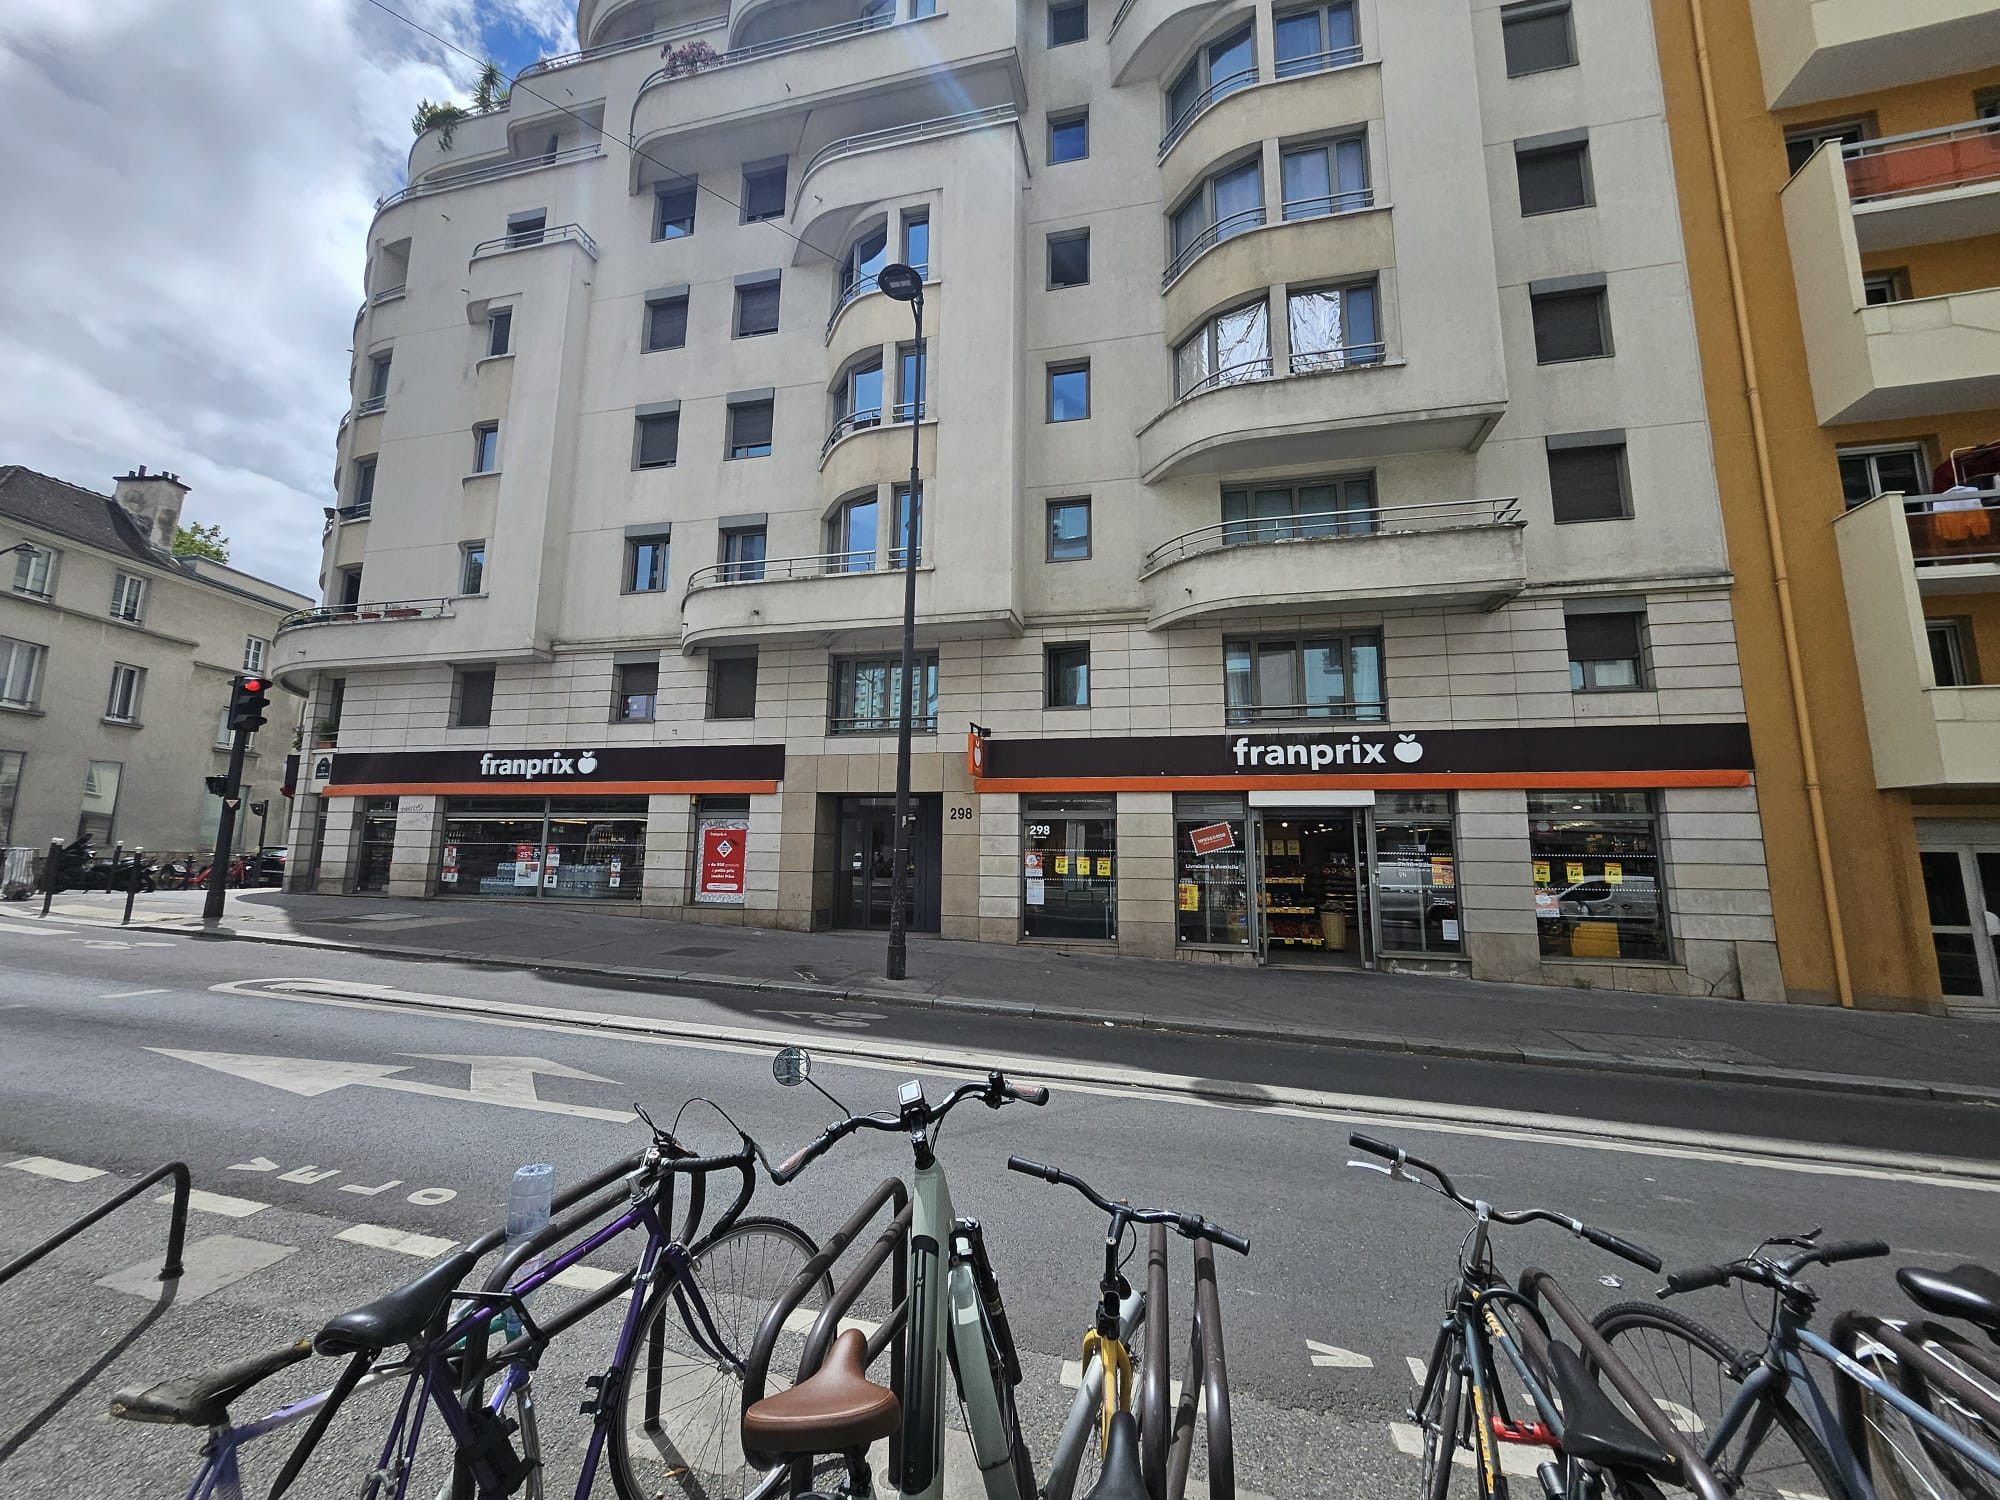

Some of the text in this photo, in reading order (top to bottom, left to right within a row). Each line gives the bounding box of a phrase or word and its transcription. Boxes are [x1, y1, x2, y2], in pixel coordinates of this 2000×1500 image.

[480, 752, 574, 780] franprix
[1233, 735, 1386, 771] franprix
[950, 807, 973, 820] 298
[1030, 825, 1050, 835] 298
[226, 1156, 458, 1206] VELO
